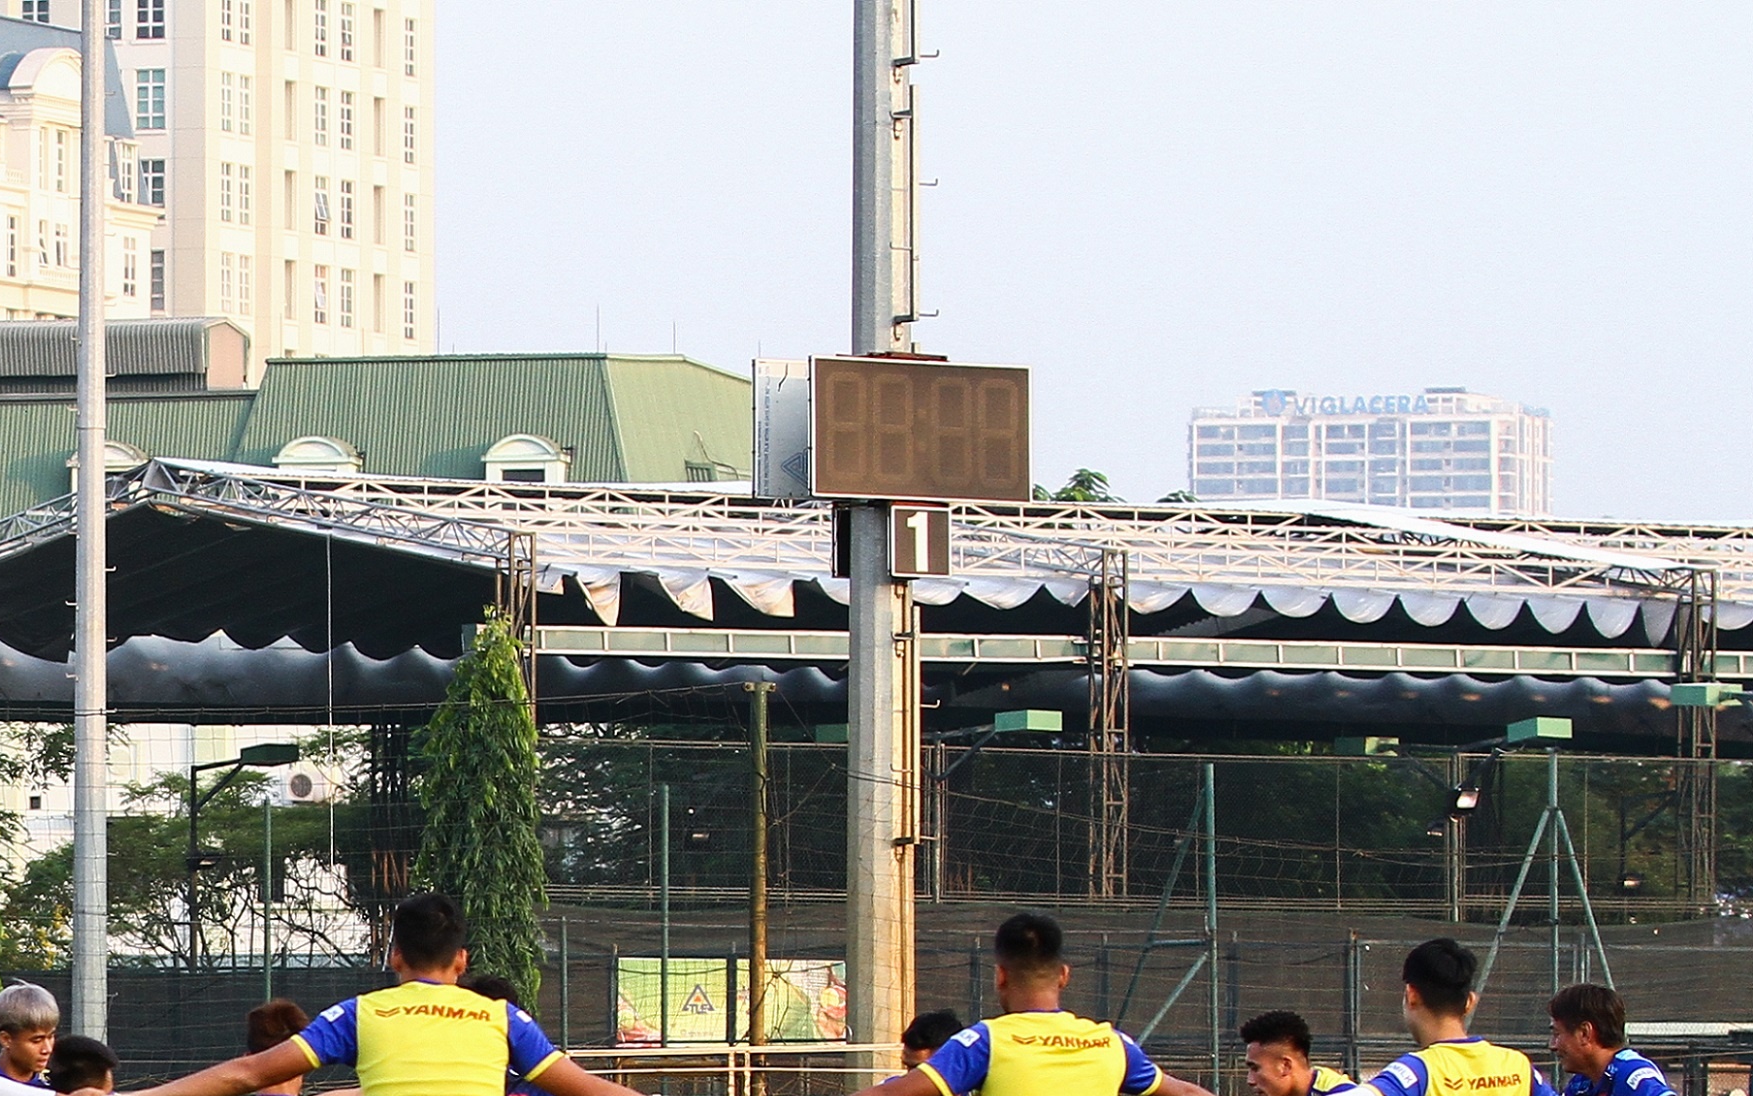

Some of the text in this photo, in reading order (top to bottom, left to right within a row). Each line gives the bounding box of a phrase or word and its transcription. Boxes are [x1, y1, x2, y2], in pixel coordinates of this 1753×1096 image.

[1294, 395, 1428, 414] VIGLACERA
[907, 511, 929, 573] 1
[403, 1005, 491, 1022] YANMAR
[1468, 1074, 1522, 1091] YANMAR
